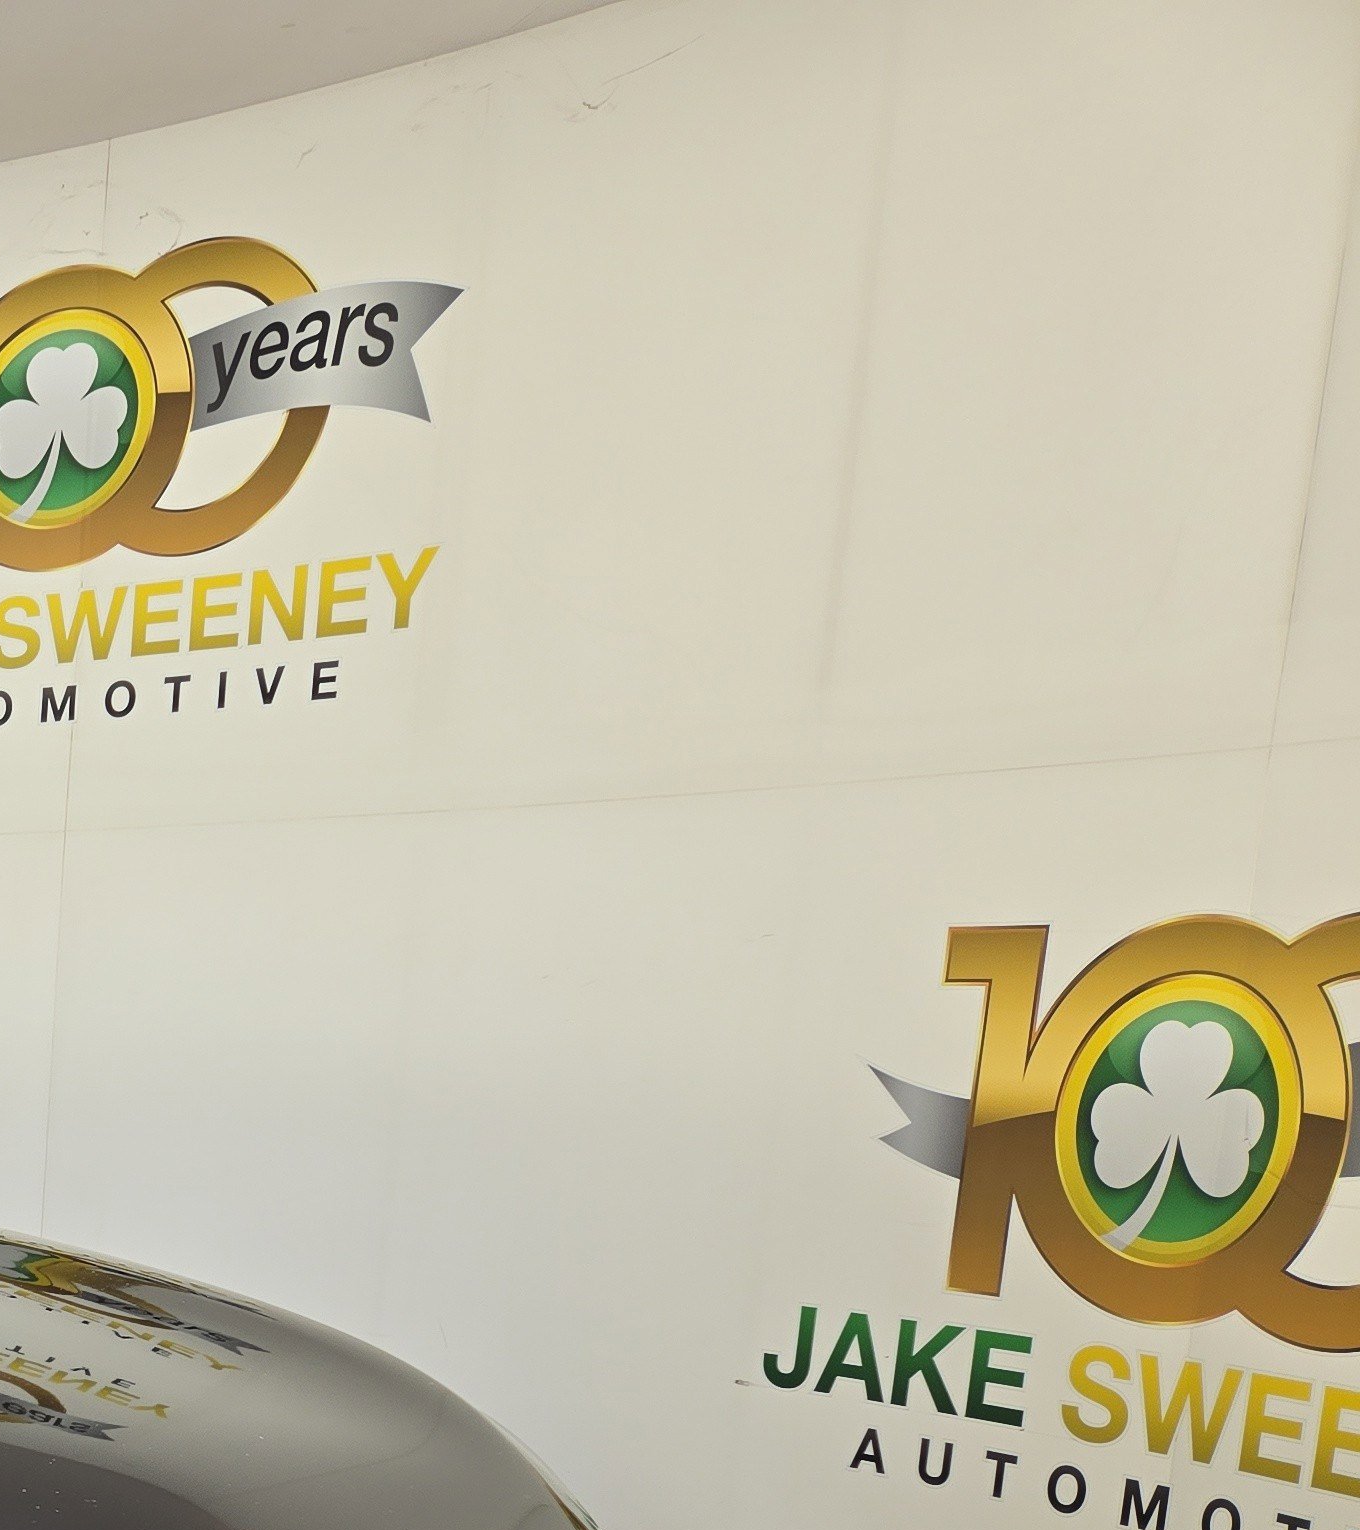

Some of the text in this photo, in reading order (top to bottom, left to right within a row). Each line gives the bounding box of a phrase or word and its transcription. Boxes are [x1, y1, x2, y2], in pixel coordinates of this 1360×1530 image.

[207, 300, 400, 412] years
[763, 1305, 1360, 1499] JAKE SWEE
